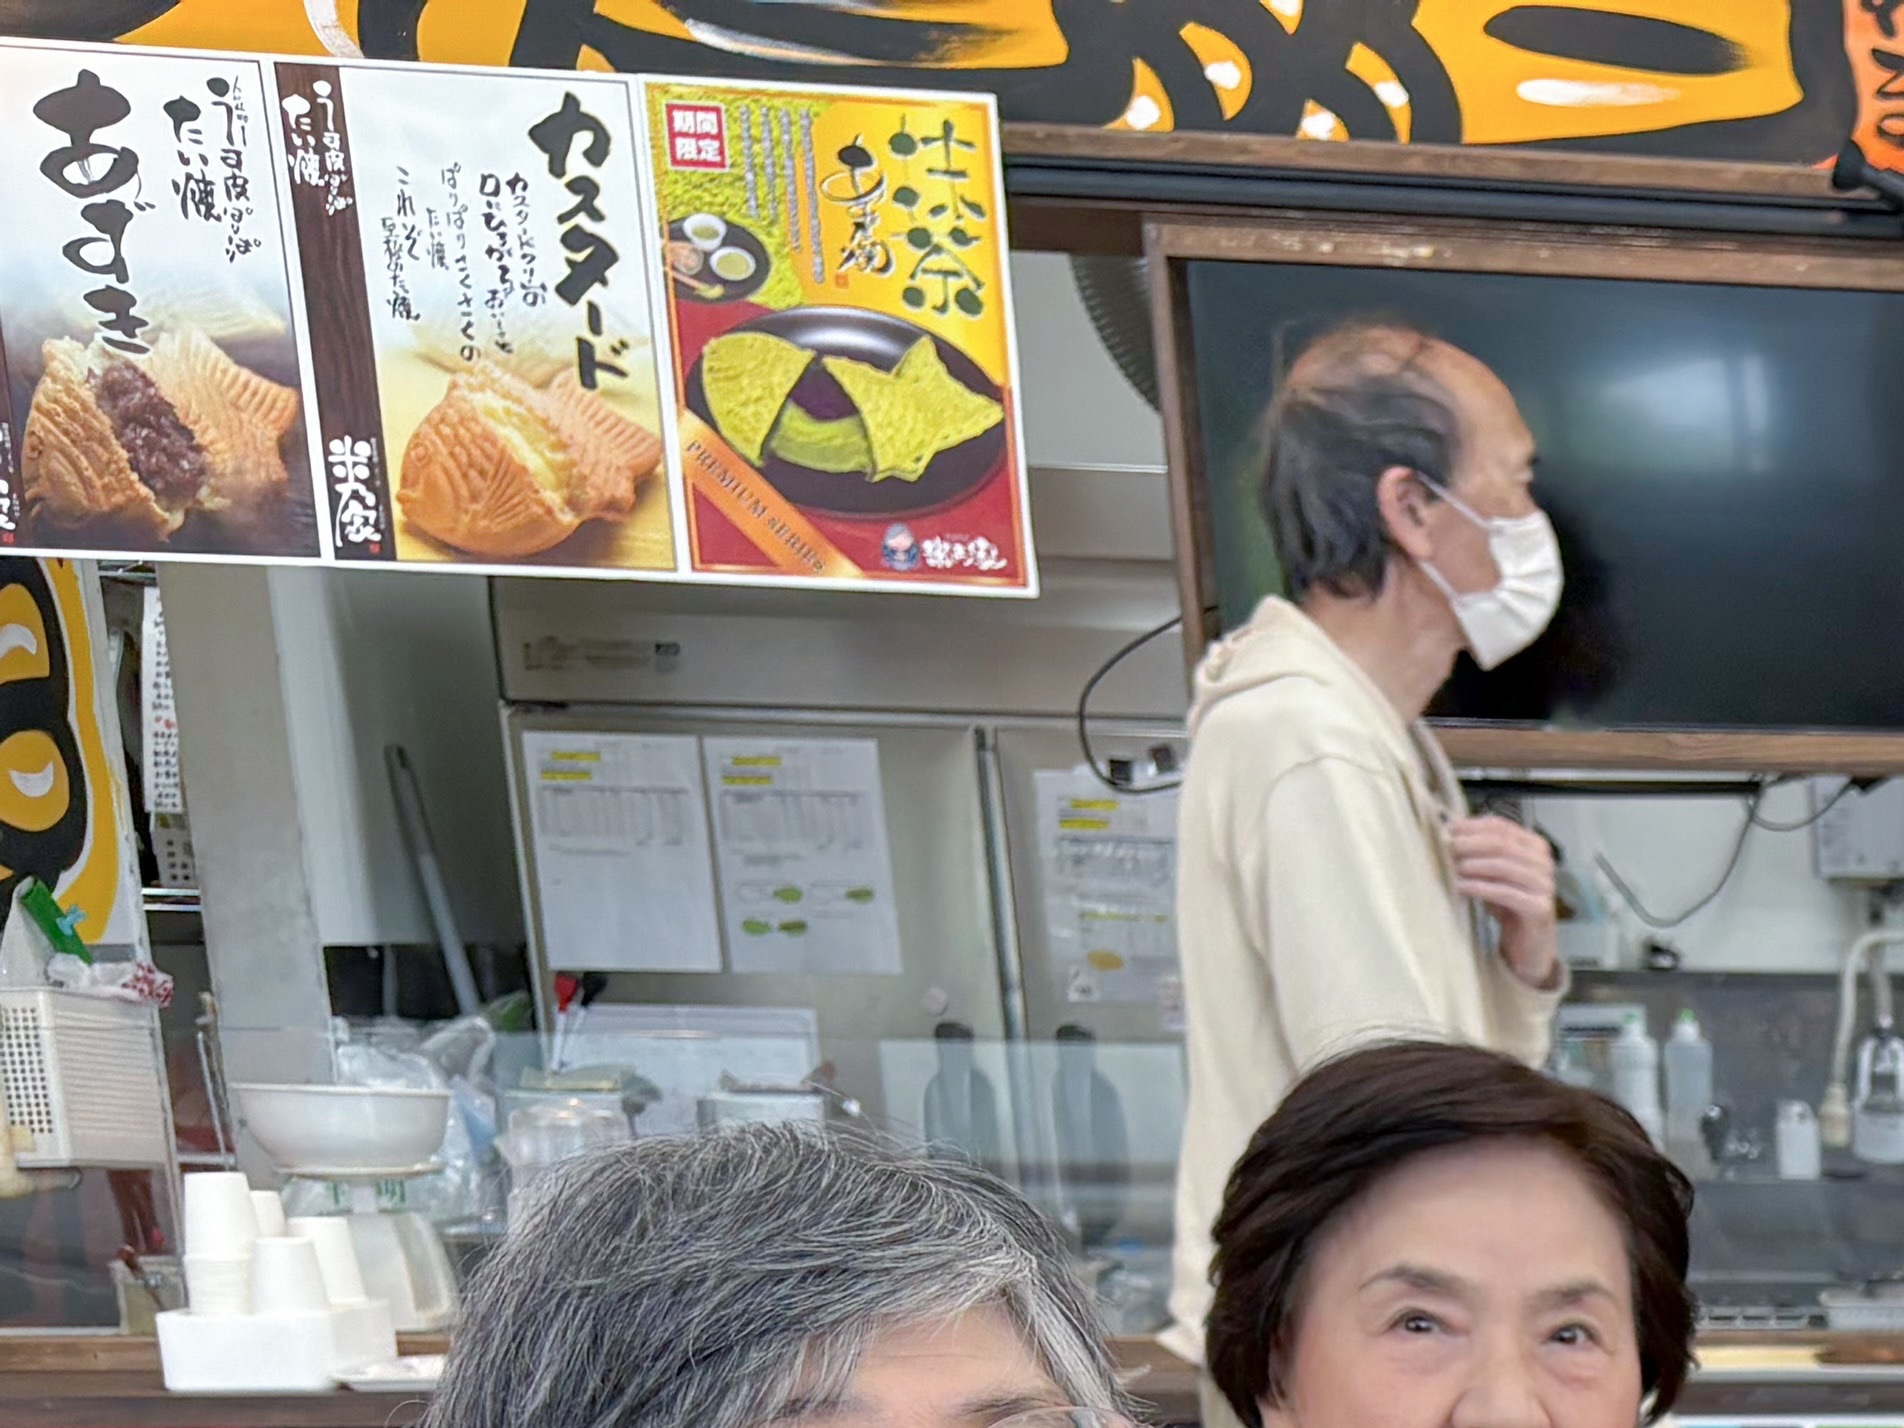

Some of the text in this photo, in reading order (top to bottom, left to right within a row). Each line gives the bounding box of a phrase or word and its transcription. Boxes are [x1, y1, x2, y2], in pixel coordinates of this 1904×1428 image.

[674, 110, 720, 134] 期間
[675, 139, 723, 163] 限定
[33, 68, 156, 355] あずき
[527, 91, 630, 391] カスタード
[687, 441, 767, 520] PREMIUM
